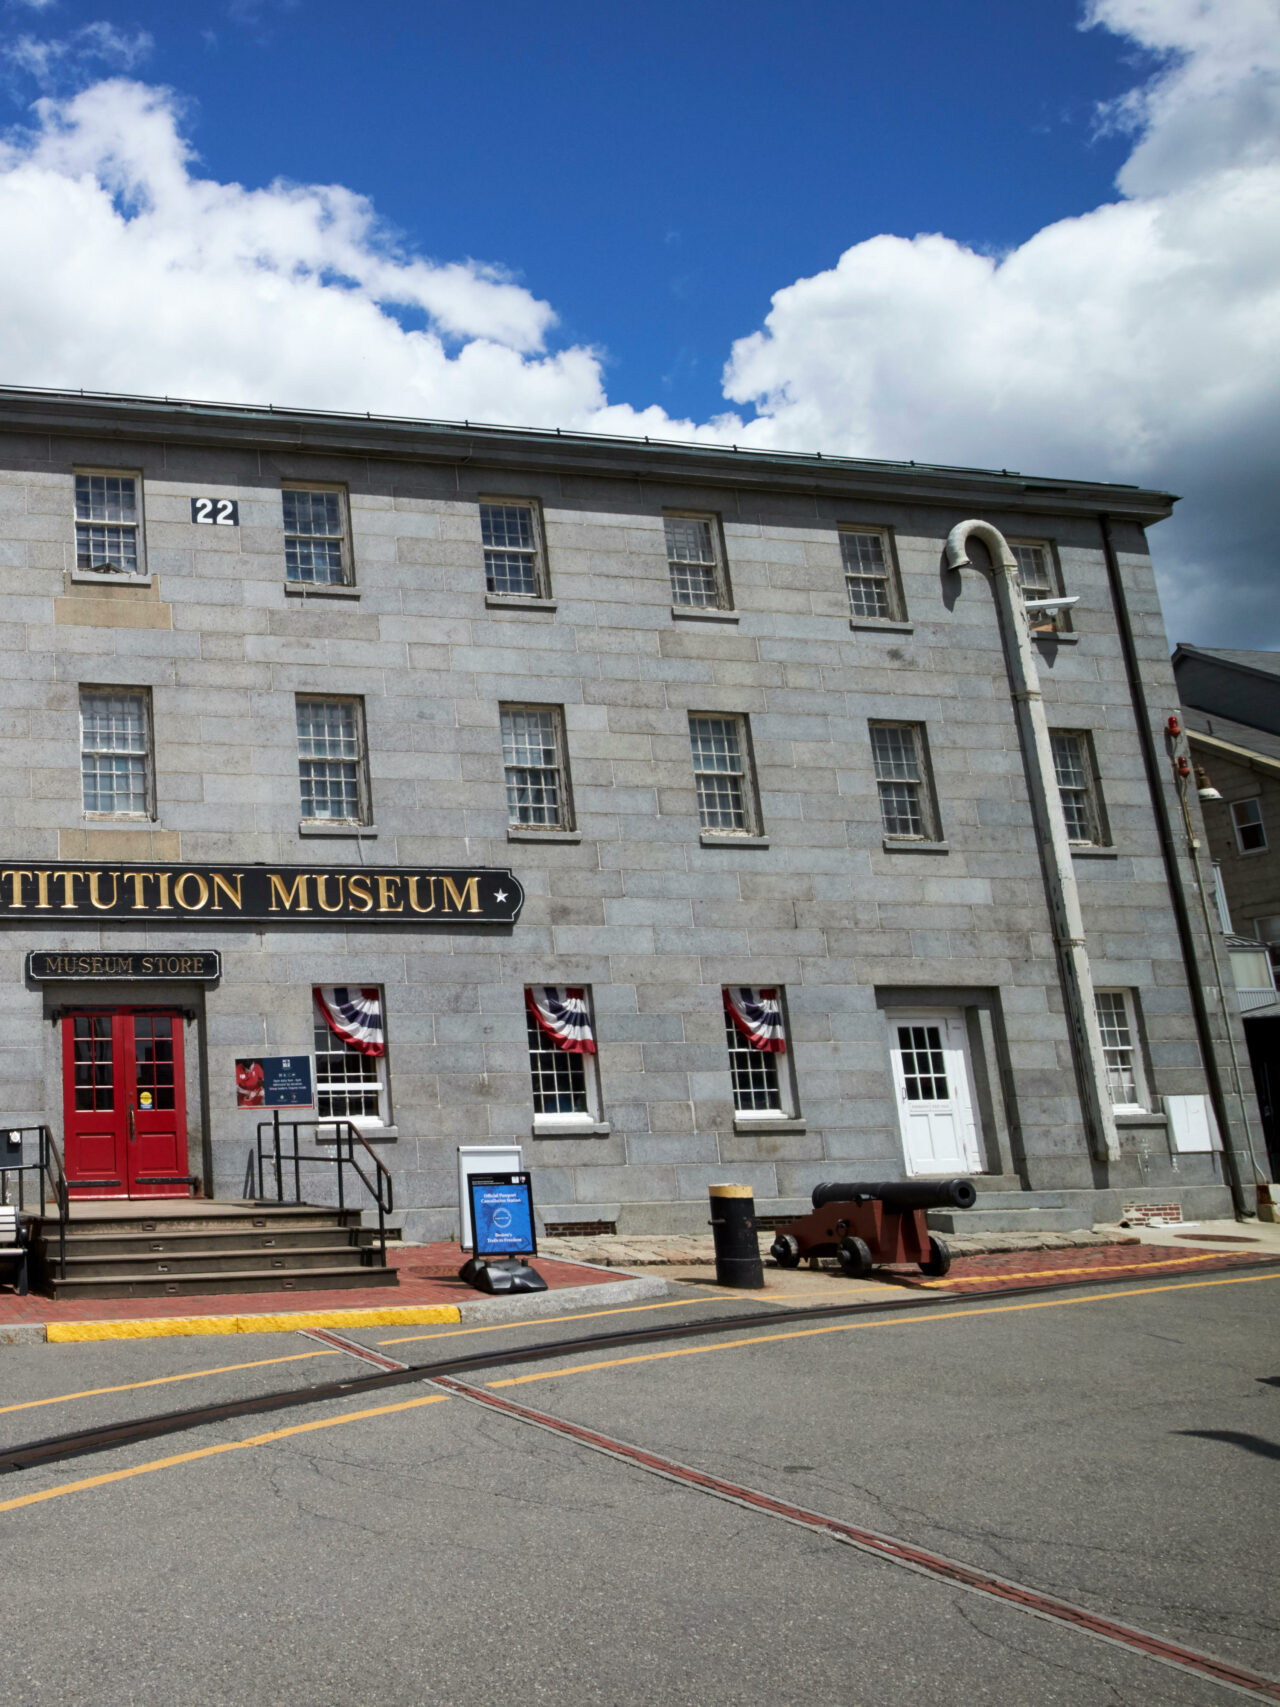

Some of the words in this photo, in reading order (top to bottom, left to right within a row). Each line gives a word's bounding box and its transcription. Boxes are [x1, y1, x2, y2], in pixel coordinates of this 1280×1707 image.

[195, 498, 235, 526] 22
[266, 873, 484, 913] MUSEUM
[45, 956, 134, 974] MUSEUM
[141, 956, 205, 974] STORE
